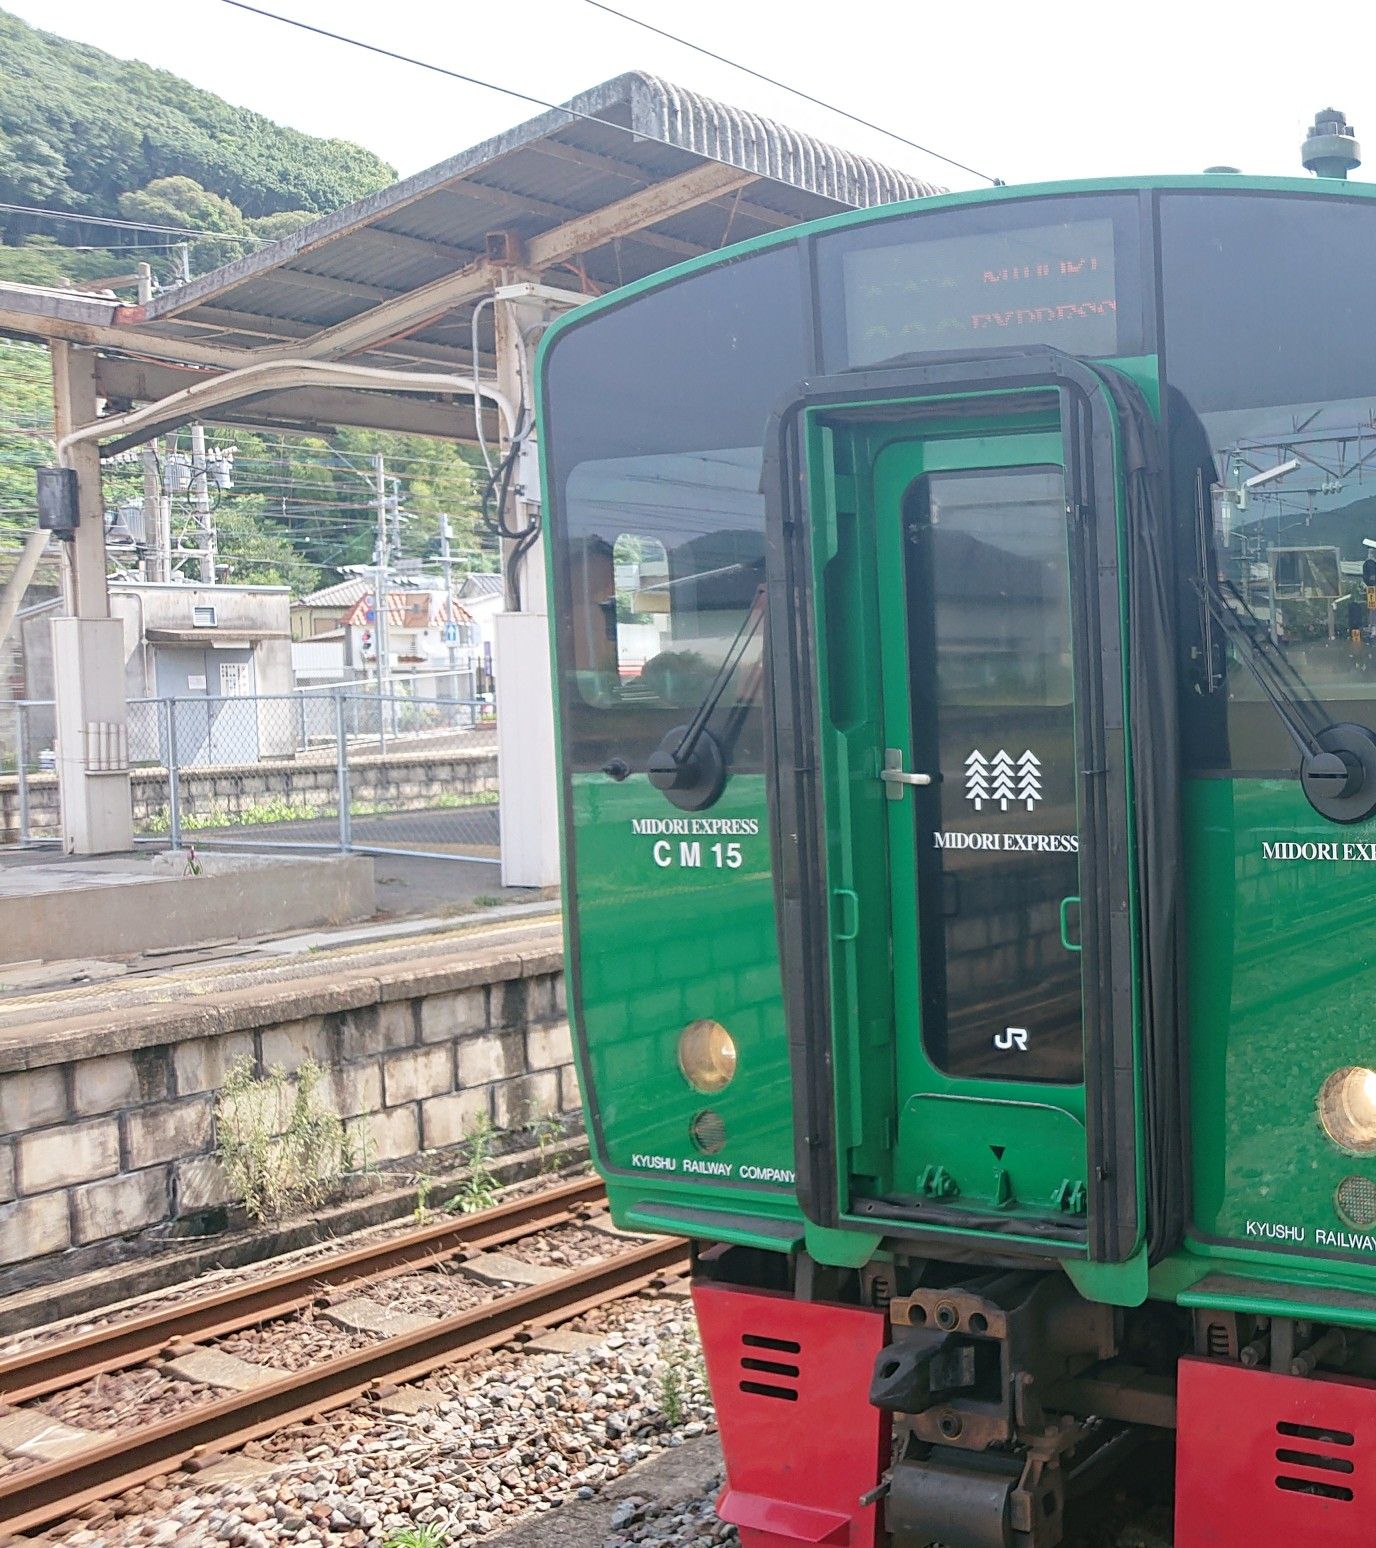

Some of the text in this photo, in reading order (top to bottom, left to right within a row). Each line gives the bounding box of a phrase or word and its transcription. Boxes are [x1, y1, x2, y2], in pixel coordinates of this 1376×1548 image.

[631, 818, 759, 835] MIDORI EXPRESS
[933, 831, 1079, 852] MIDORI EXPRESS
[1262, 842, 1339, 861] MIDORI
[711, 843, 743, 868] 15
[995, 1027, 1028, 1051] JR
[631, 1154, 796, 1183] KYUSHU RAILWAY COMPANY
[1246, 1220, 1305, 1241] KYUSHU
